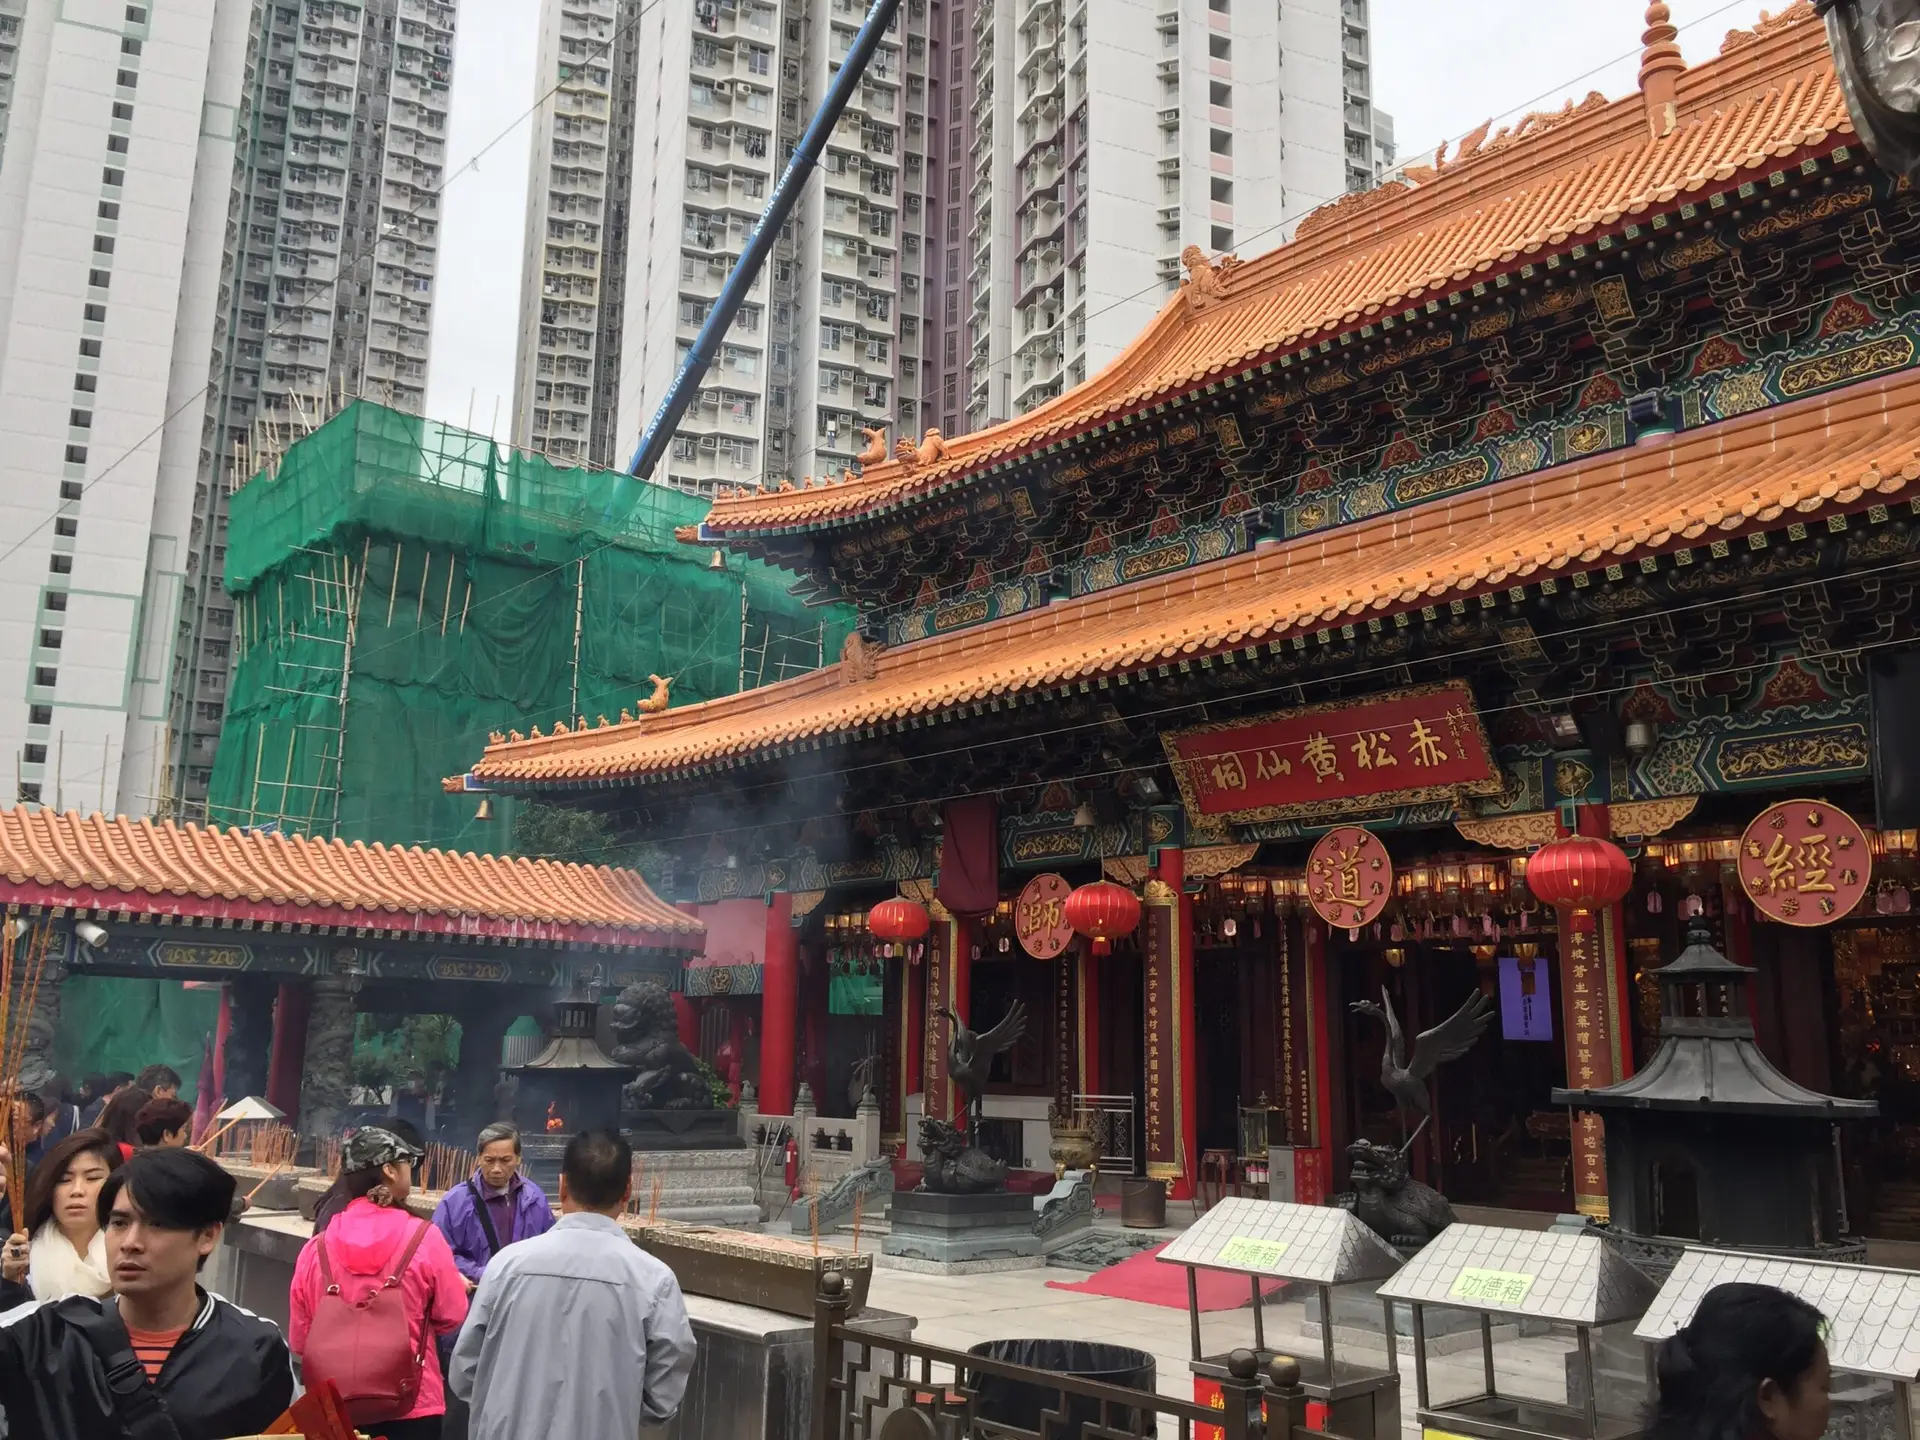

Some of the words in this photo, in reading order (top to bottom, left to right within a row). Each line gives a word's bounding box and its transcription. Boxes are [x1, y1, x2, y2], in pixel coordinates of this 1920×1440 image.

[752, 199, 775, 237] KWUN
[773, 164, 793, 197] TUNG
[645, 402, 668, 440] KWUN
[666, 366, 686, 399] TUNG
[1323, 845, 1375, 908] 道
[1764, 833, 1835, 897] 經
[1029, 893, 1060, 940] 師
[1224, 1242, 1281, 1265] 功德箱
[1458, 1274, 1528, 1301] 功德箱
